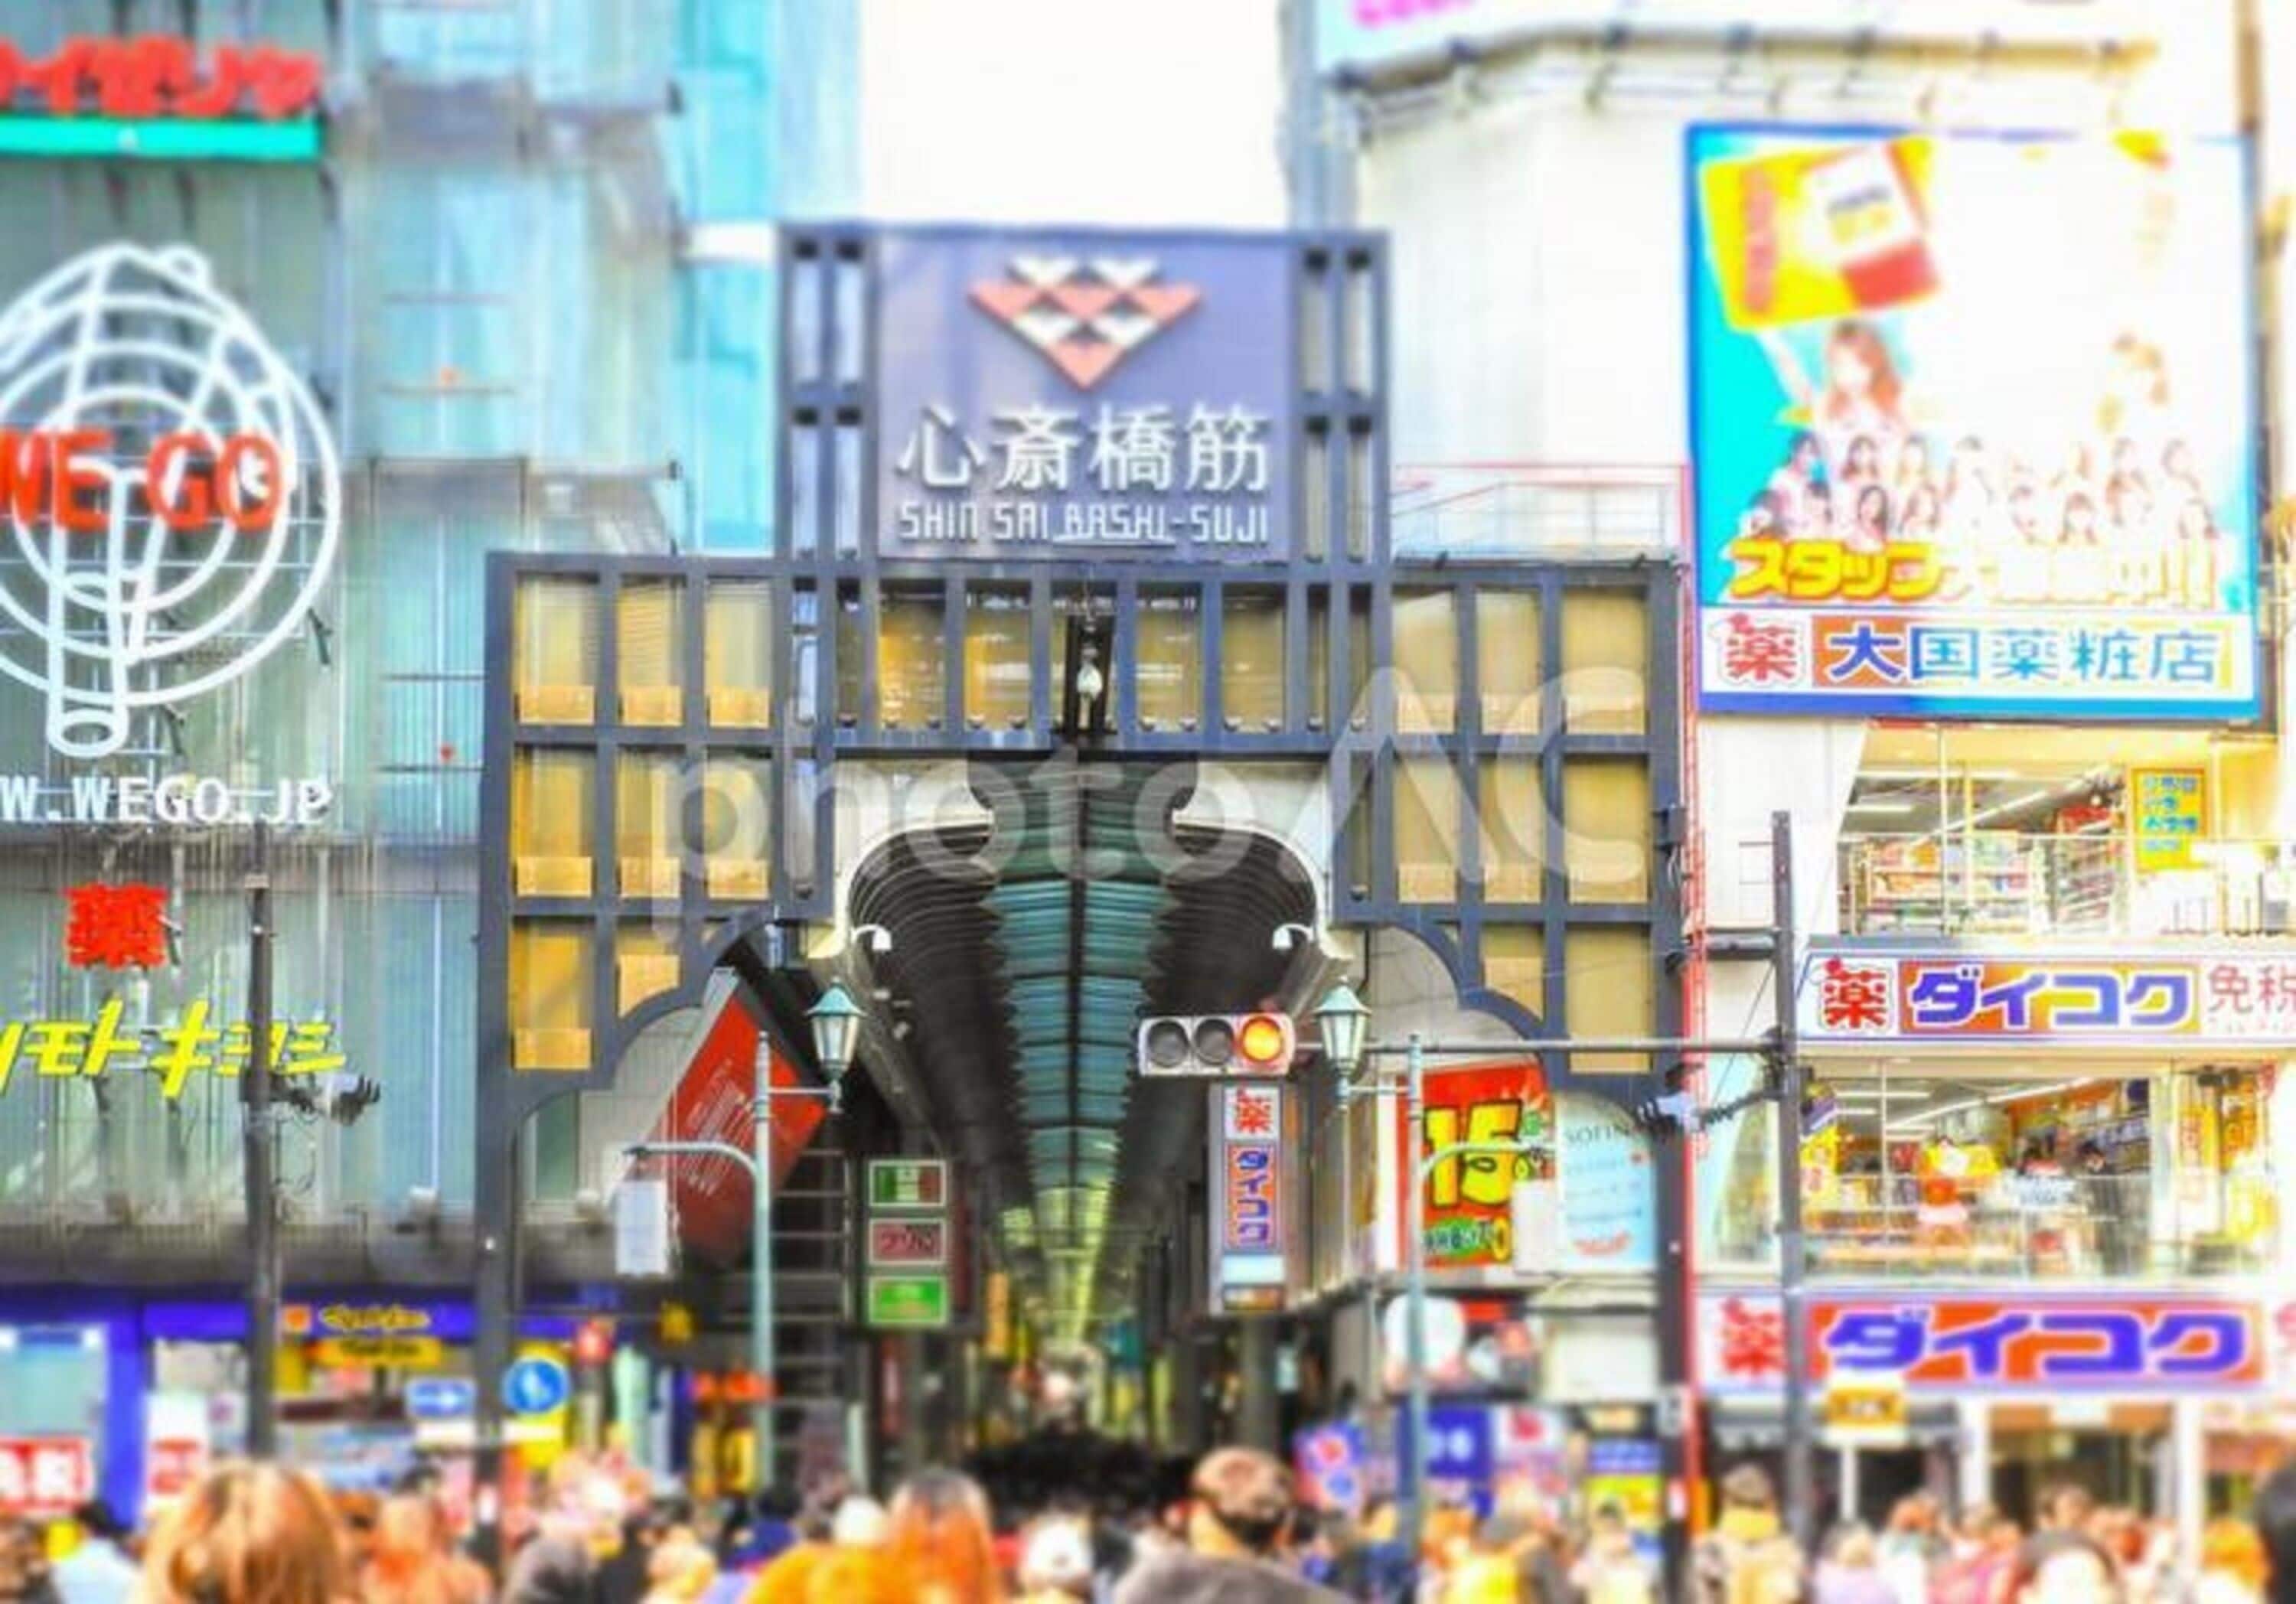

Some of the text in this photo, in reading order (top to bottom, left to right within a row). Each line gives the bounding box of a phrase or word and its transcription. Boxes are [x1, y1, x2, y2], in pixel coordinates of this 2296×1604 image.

[897, 403, 1270, 491] 心斎橋筋
[900, 500, 978, 540] SHIN
[1823, 957, 1886, 1029] 薬
[1912, 967, 2190, 1027] ダイコク
[1826, 1309, 2244, 1376] ダイコク
